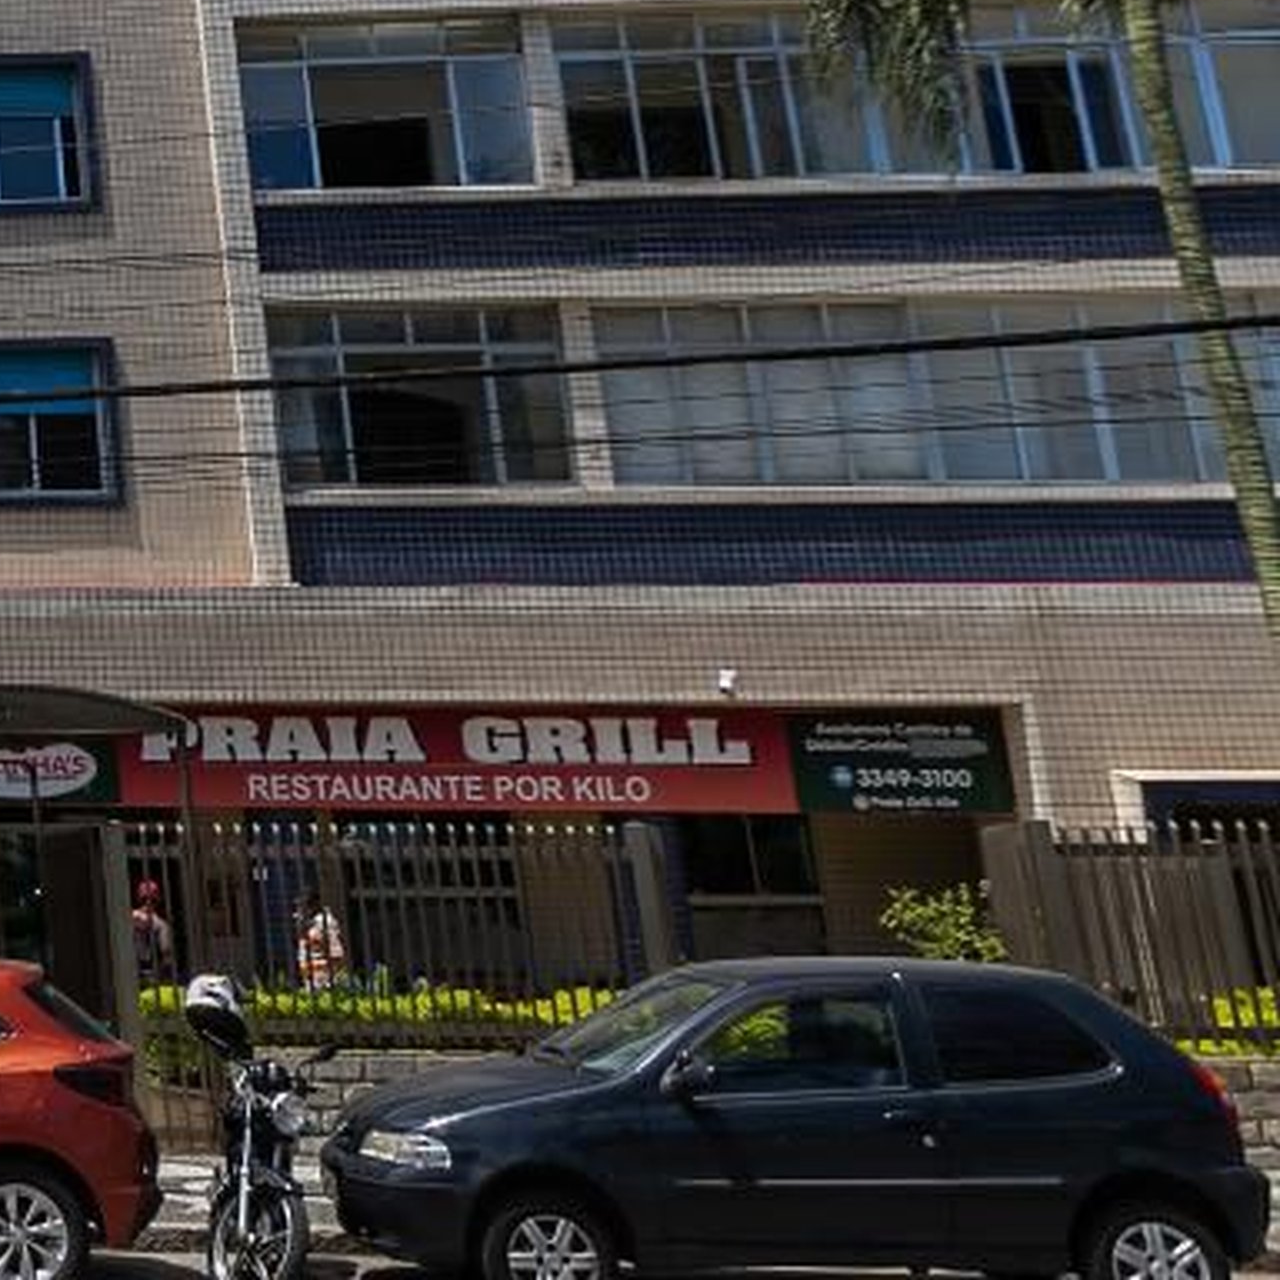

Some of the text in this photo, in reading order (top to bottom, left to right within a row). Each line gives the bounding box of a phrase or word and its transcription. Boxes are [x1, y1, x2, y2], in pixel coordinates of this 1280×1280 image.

[140, 717, 752, 764] PRAIA GRILL
[247, 774, 651, 802] RESTAURANTE POR KILO
[856, 768, 973, 788] 3349-3100
